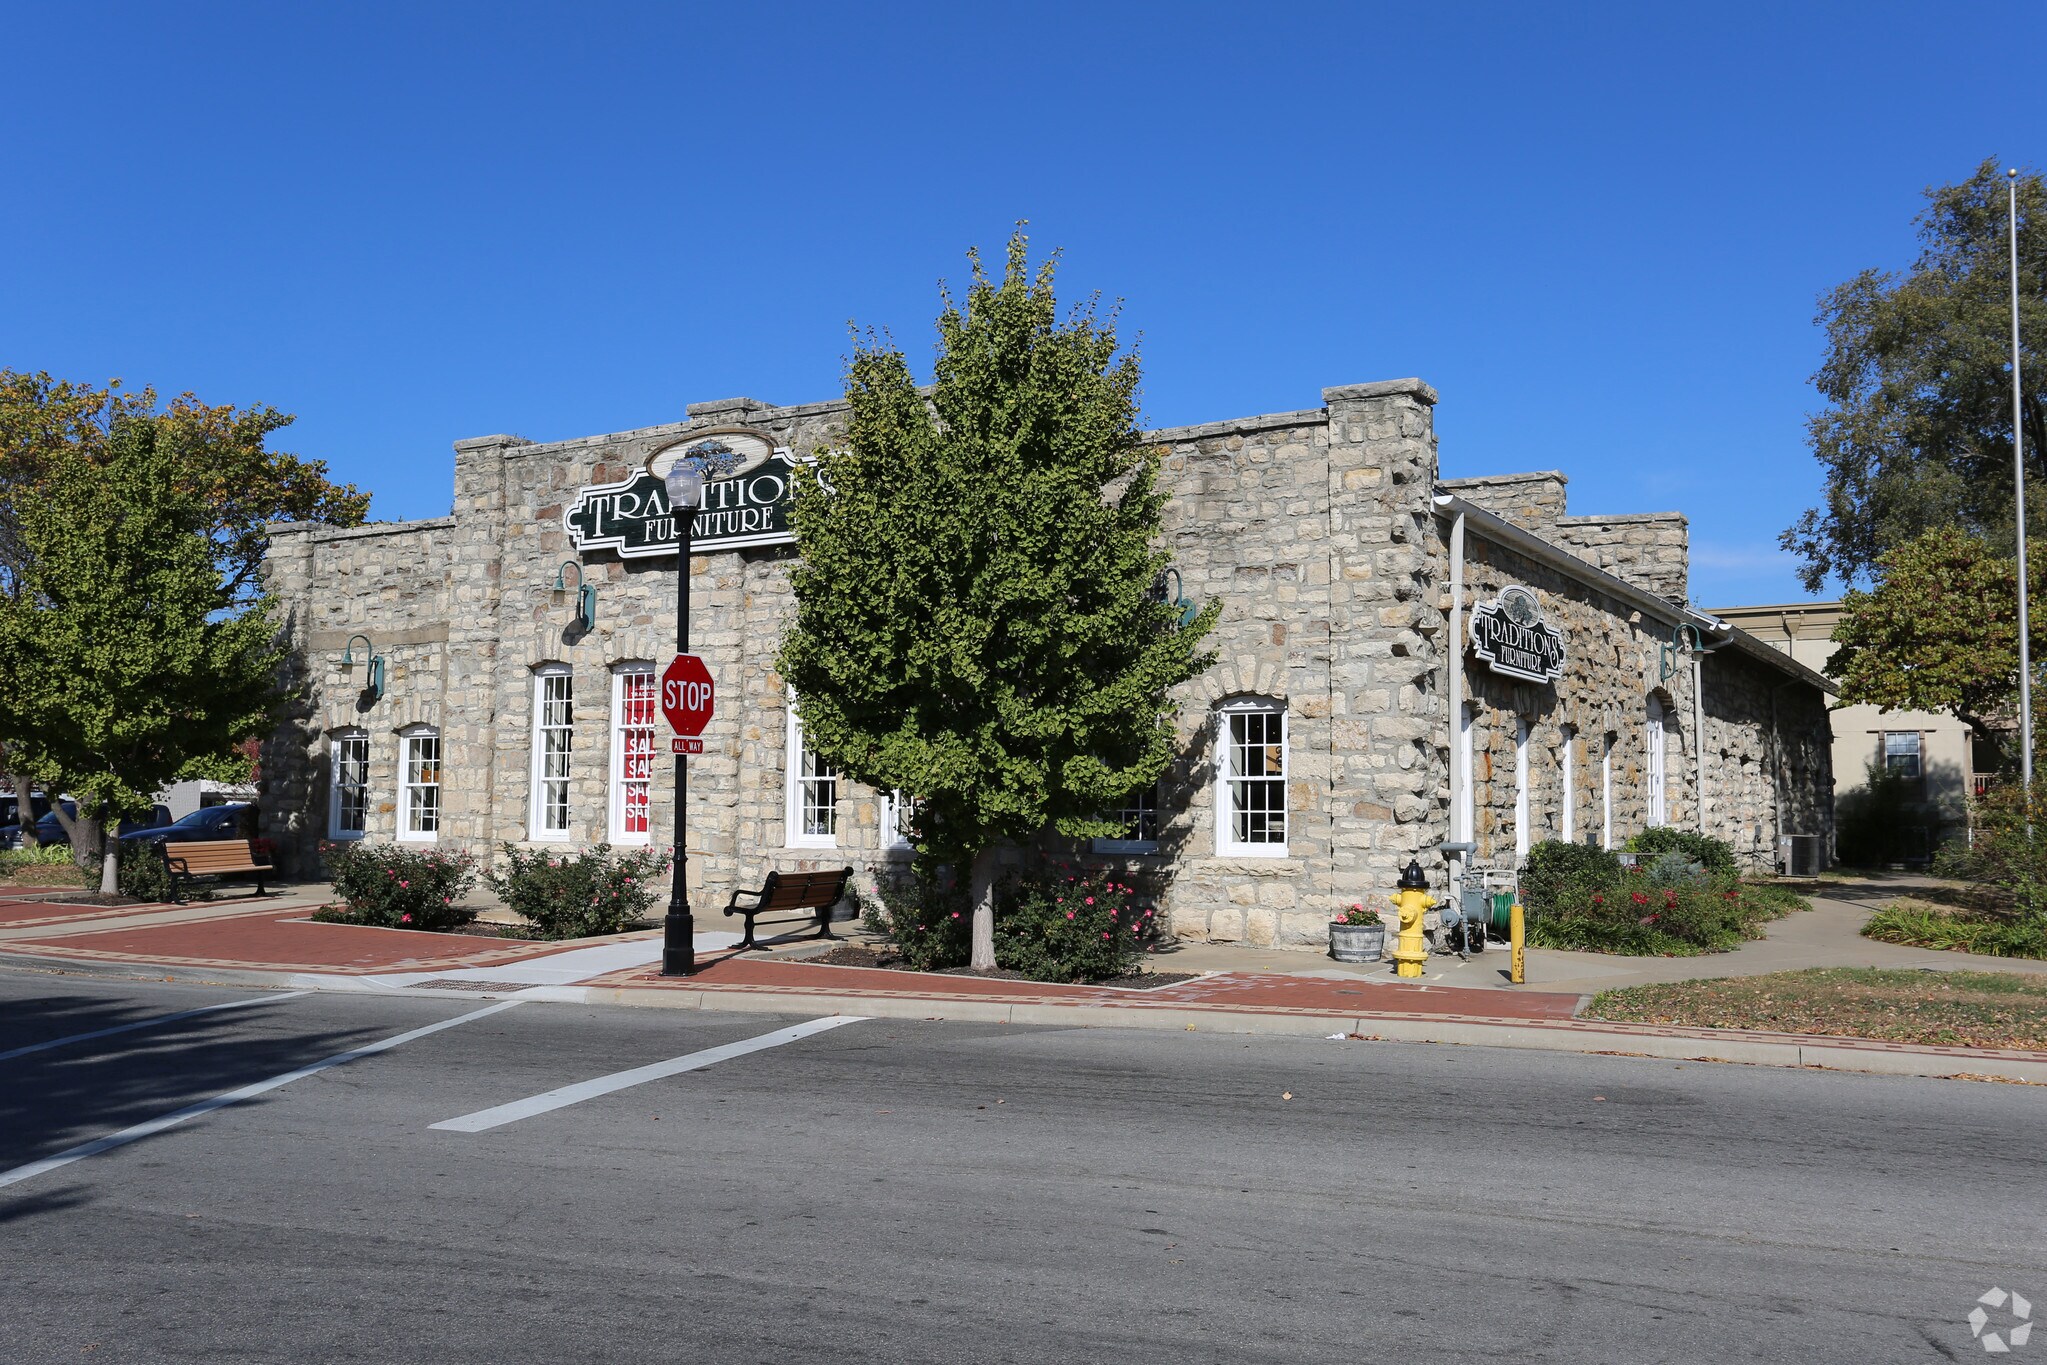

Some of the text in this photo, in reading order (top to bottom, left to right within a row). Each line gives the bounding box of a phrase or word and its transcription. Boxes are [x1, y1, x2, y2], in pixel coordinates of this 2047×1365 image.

[588, 468, 837, 537] TRAITIOS
[1481, 613, 1559, 669] TRADITIONS
[1501, 645, 1541, 672] FURNITURE
[665, 680, 711, 712] STOP
[630, 716, 655, 731] SAL
[629, 738, 656, 753] SAL
[674, 741, 702, 752] ALL WAY
[628, 759, 651, 775] SAL
